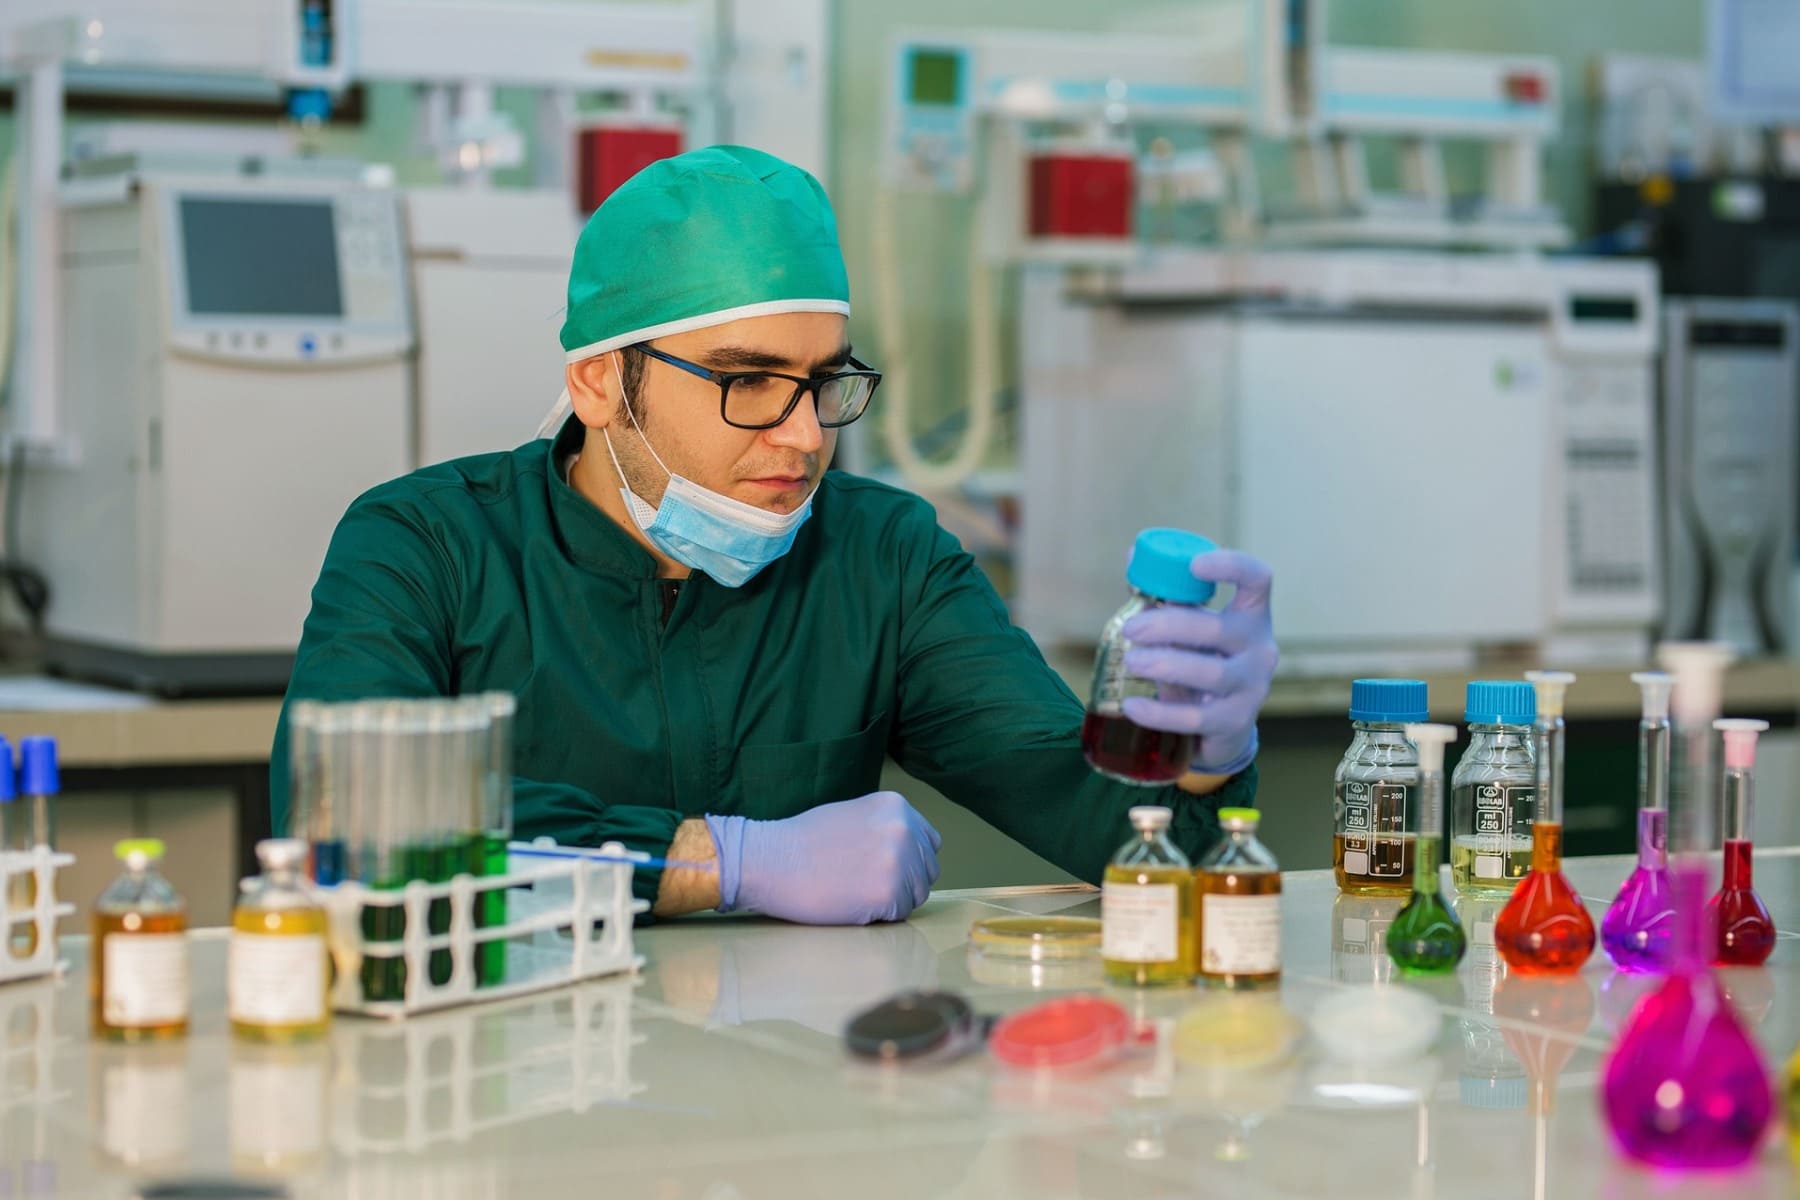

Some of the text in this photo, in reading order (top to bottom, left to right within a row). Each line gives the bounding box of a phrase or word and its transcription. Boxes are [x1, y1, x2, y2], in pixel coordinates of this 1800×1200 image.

[1351, 808, 1362, 816] ml
[1484, 812, 1496, 820] ml
[1348, 816, 1364, 826] 250
[1480, 820, 1499, 829] 250
[1390, 838, 1402, 846] 100
